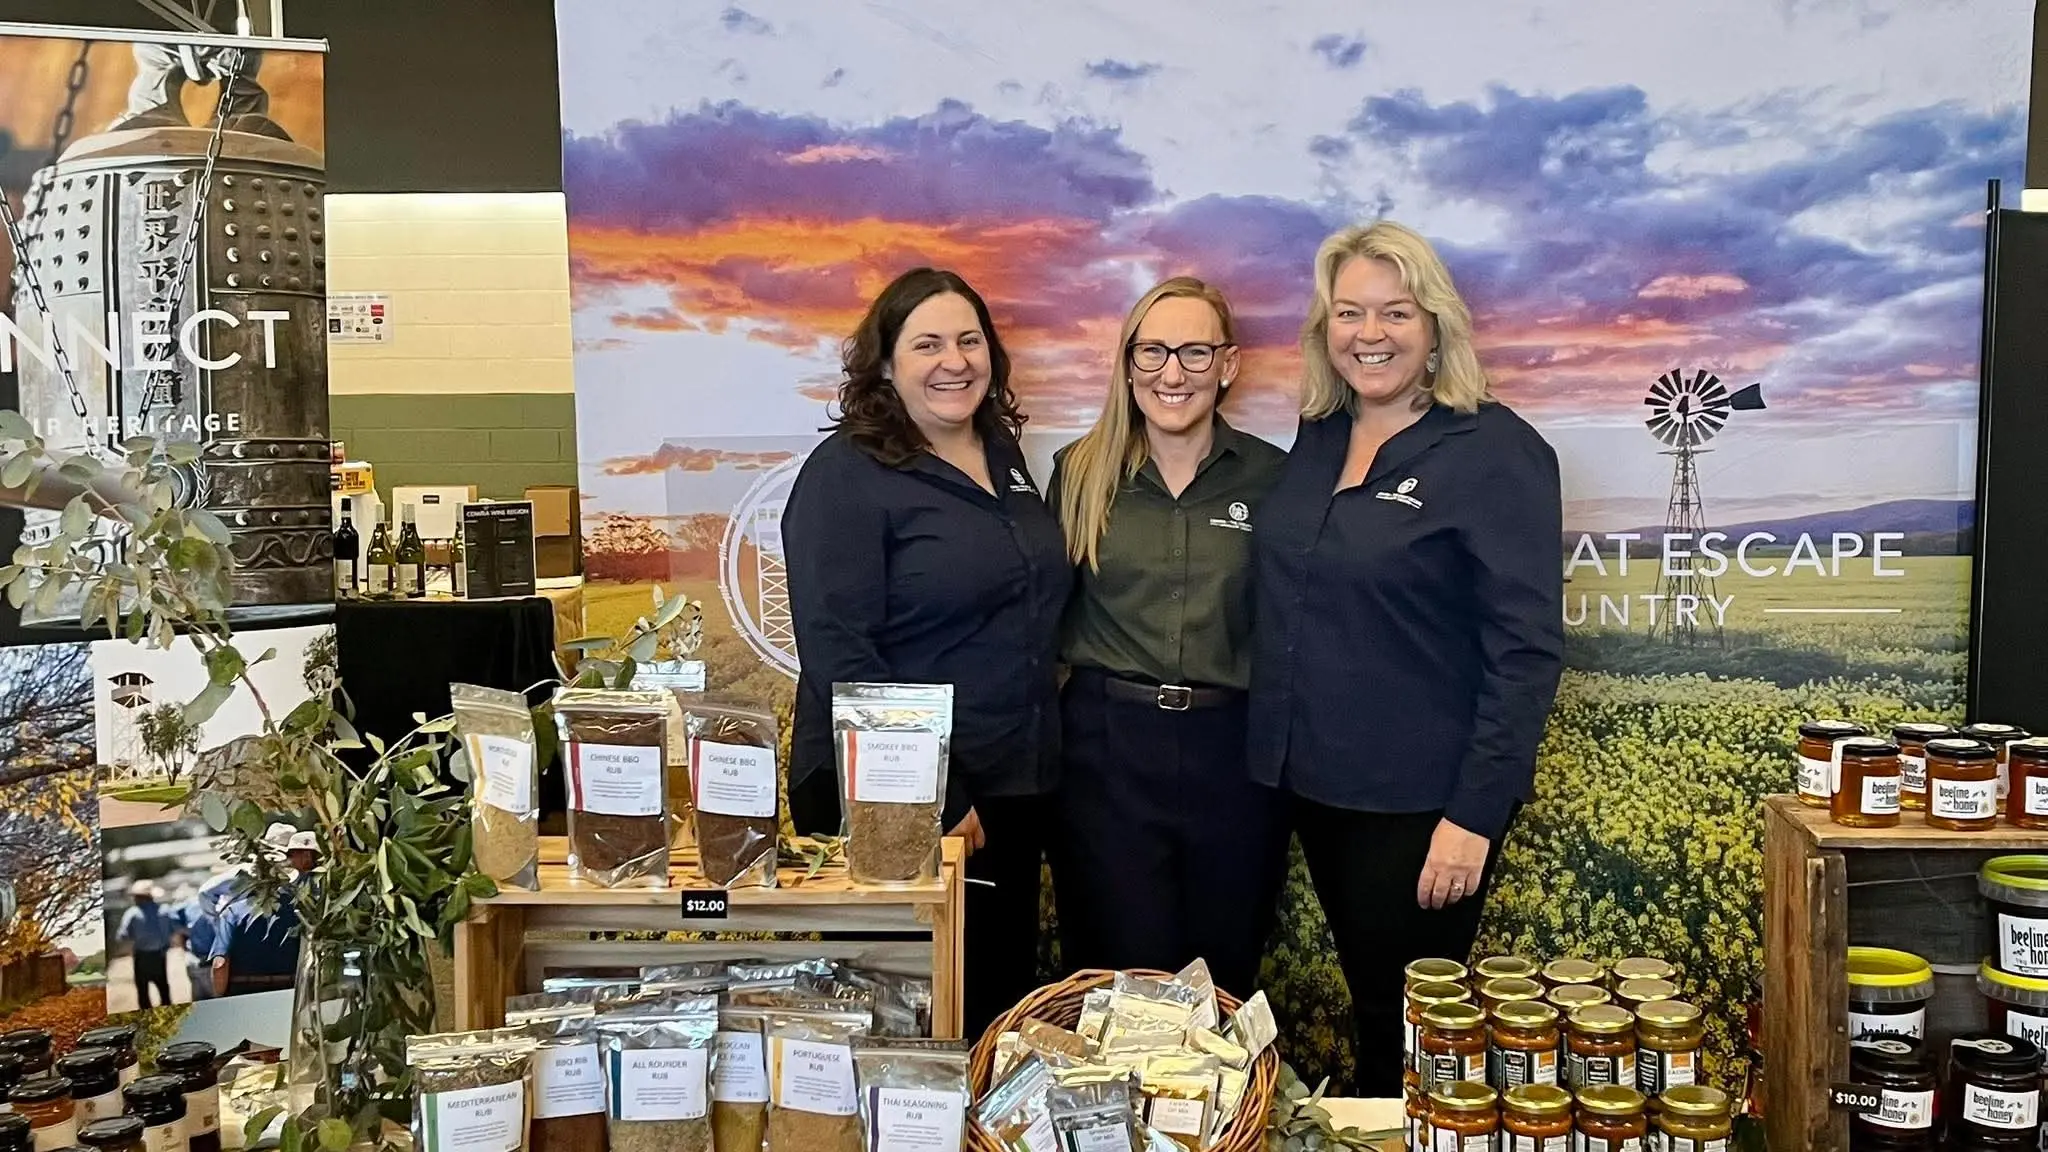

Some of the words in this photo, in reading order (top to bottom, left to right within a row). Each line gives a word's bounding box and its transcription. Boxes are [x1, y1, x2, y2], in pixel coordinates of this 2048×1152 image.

[0, 310, 290, 373] NNECT
[82, 413, 240, 436] HERITAGE
[1564, 533, 1641, 577] AT
[1662, 532, 1905, 577] ESCAPE
[1563, 594, 1735, 626] UNTRY
[867, 743, 899, 752] SMOKEY
[901, 743, 918, 752] BBQ
[590, 754, 621, 763] CHINESE
[622, 754, 640, 764] BBQ
[708, 754, 737, 766] CHINESE
[739, 756, 757, 767] BBQ
[883, 755, 900, 763] RUB
[606, 766, 622, 775] RUB
[722, 768, 739, 777] RUB
[1939, 784, 1970, 799] beeline
[1953, 799, 1978, 814] honey
[686, 900, 725, 912] $12.00
[793, 1049, 840, 1062] PORTUGUESE
[555, 1059, 573, 1067] BBQ
[632, 1061, 646, 1069] ALL
[648, 1060, 688, 1069] ROUNDER
[808, 1063, 825, 1072] RUB
[565, 1068, 582, 1077] RUB
[652, 1072, 669, 1080] RUB
[447, 1091, 517, 1109] MEDITERRANEAN
[883, 1098, 901, 1107] THAI
[903, 1099, 948, 1110] SEASONING
[1835, 1091, 1877, 1107] $10.00
[1973, 1091, 2005, 1108] beeline
[475, 1109, 493, 1117] RUB
[906, 1111, 923, 1120] RUB
[1882, 1107, 1908, 1121] honey
[1987, 1107, 2013, 1121] honey
